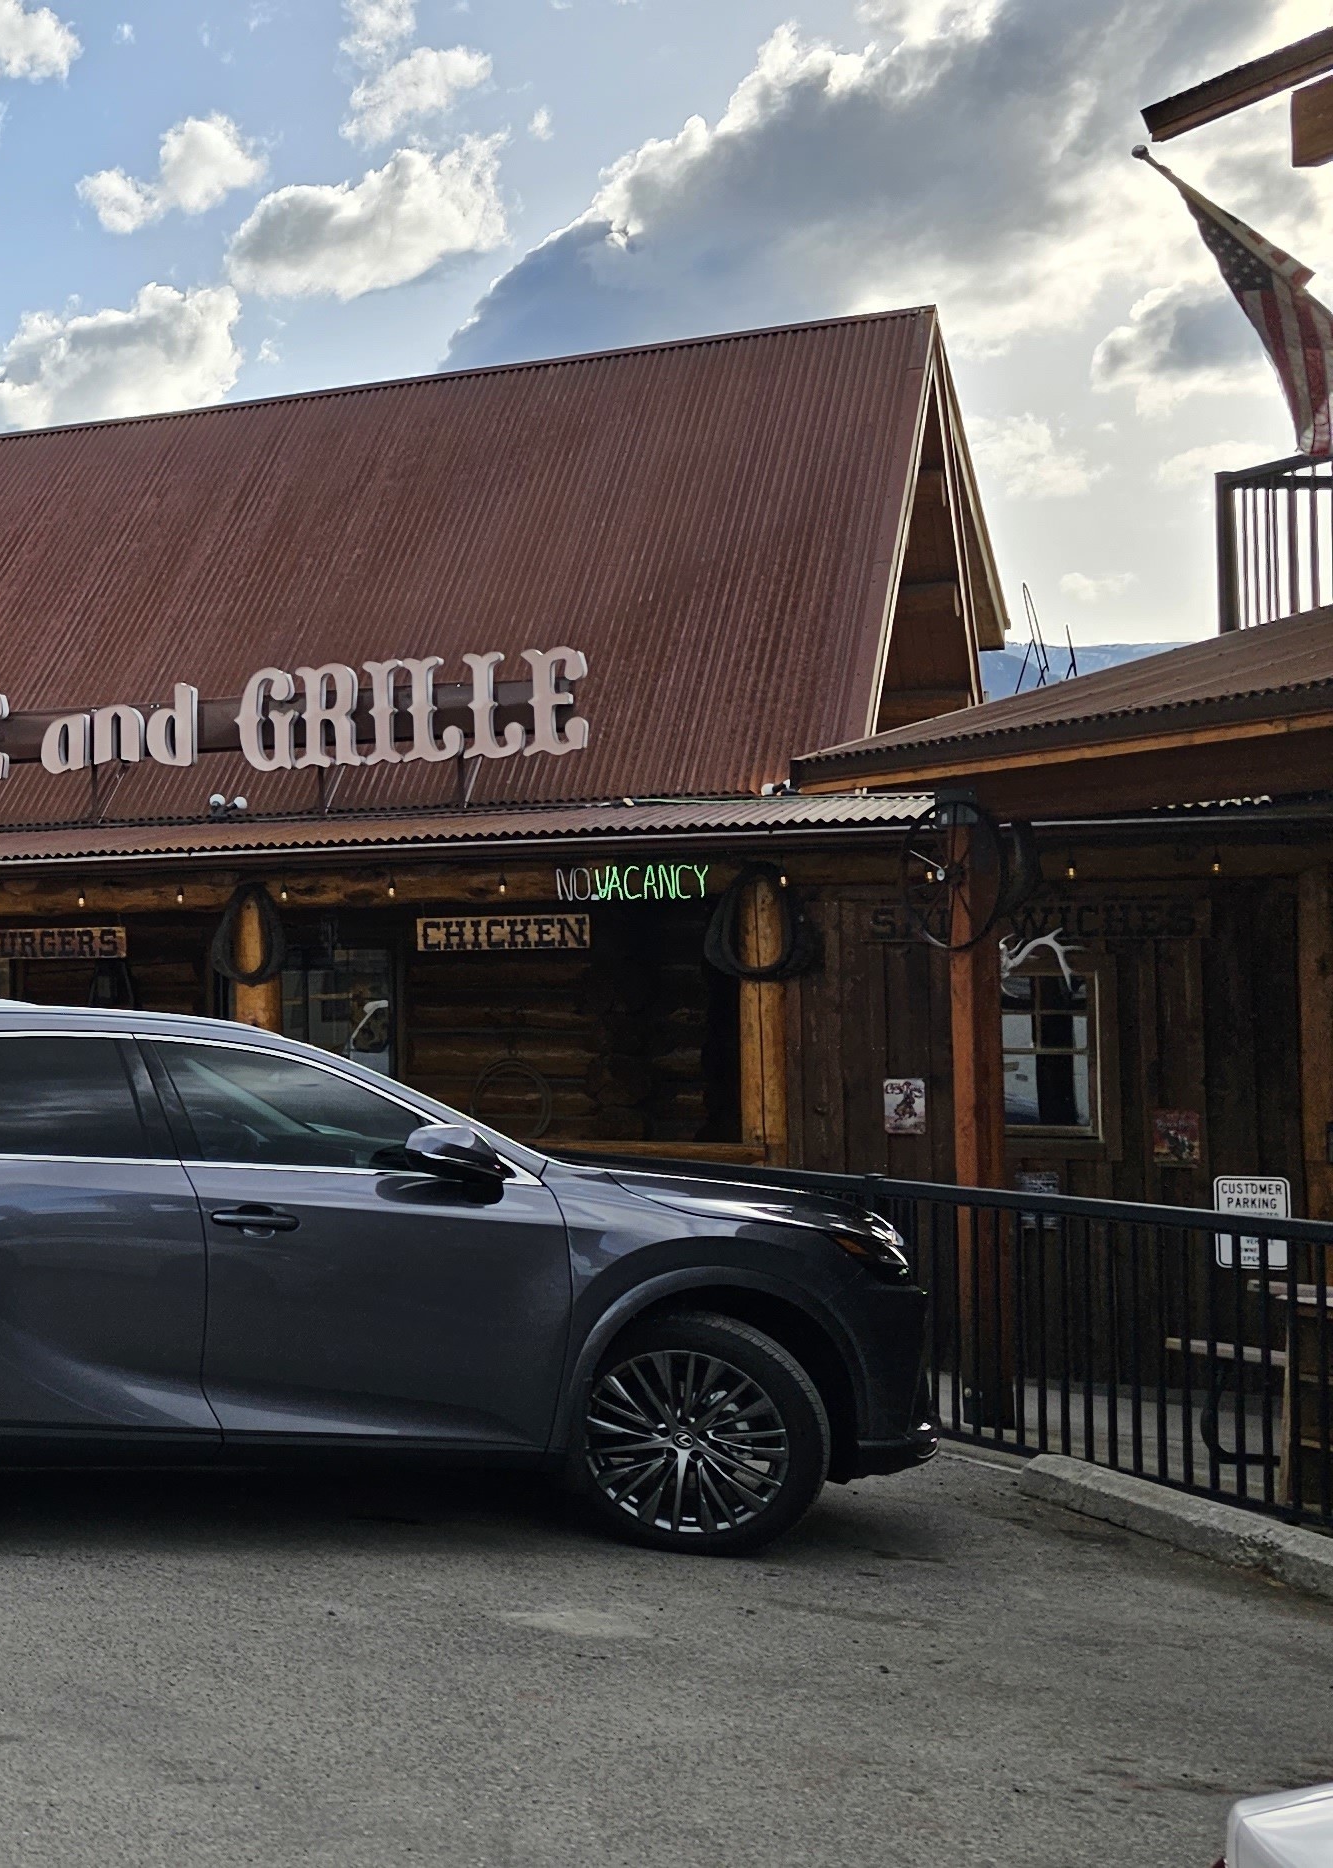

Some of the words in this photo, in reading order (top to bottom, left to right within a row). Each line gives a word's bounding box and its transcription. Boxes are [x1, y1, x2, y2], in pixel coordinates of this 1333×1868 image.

[40, 681, 200, 774] and
[234, 645, 590, 772] GRILLE
[556, 868, 590, 901] NO
[594, 864, 709, 900] VACANCY
[422, 916, 588, 950] CHICKEN
[1221, 1182, 1283, 1195] CUSTOMER
[1227, 1197, 1278, 1210] PARKING
